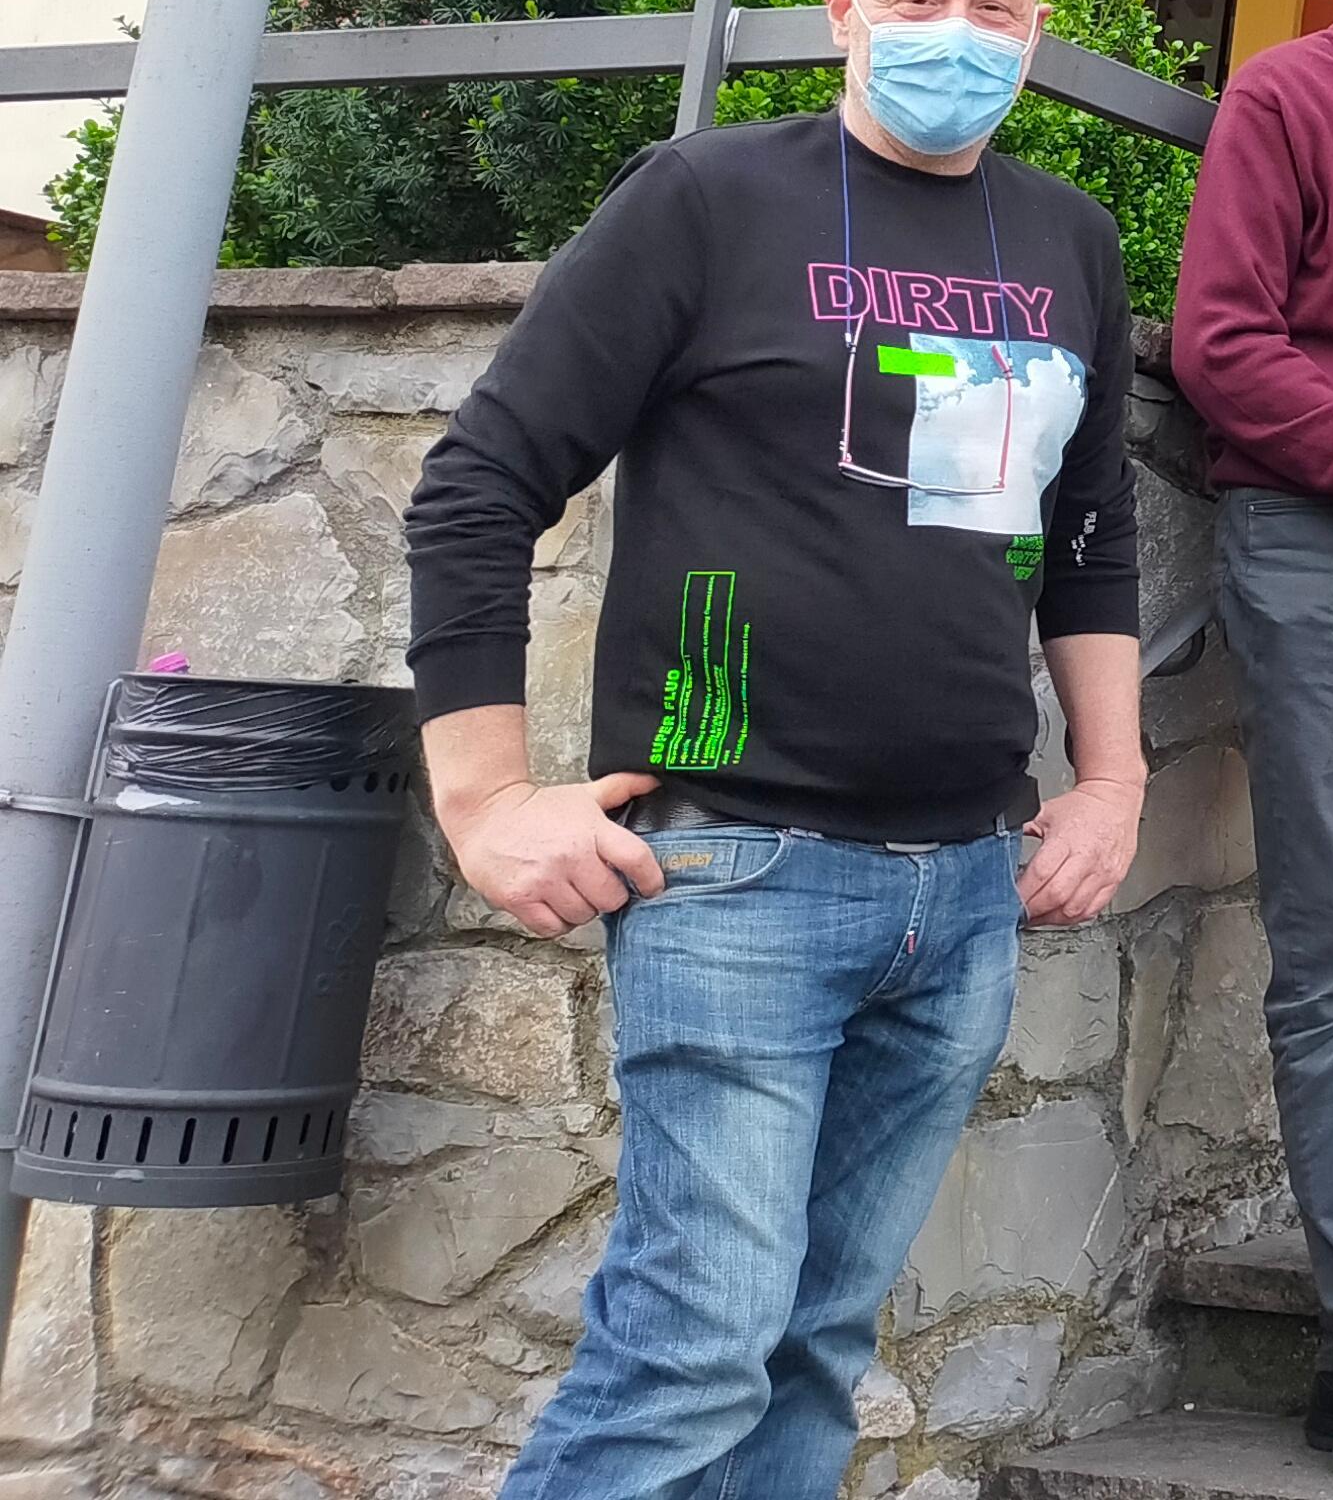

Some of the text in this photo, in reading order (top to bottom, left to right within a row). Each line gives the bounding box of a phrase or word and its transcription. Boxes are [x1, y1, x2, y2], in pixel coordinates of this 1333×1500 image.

[807, 263, 1053, 337] DIRTY
[650, 669, 680, 764] SUPER FLUO
